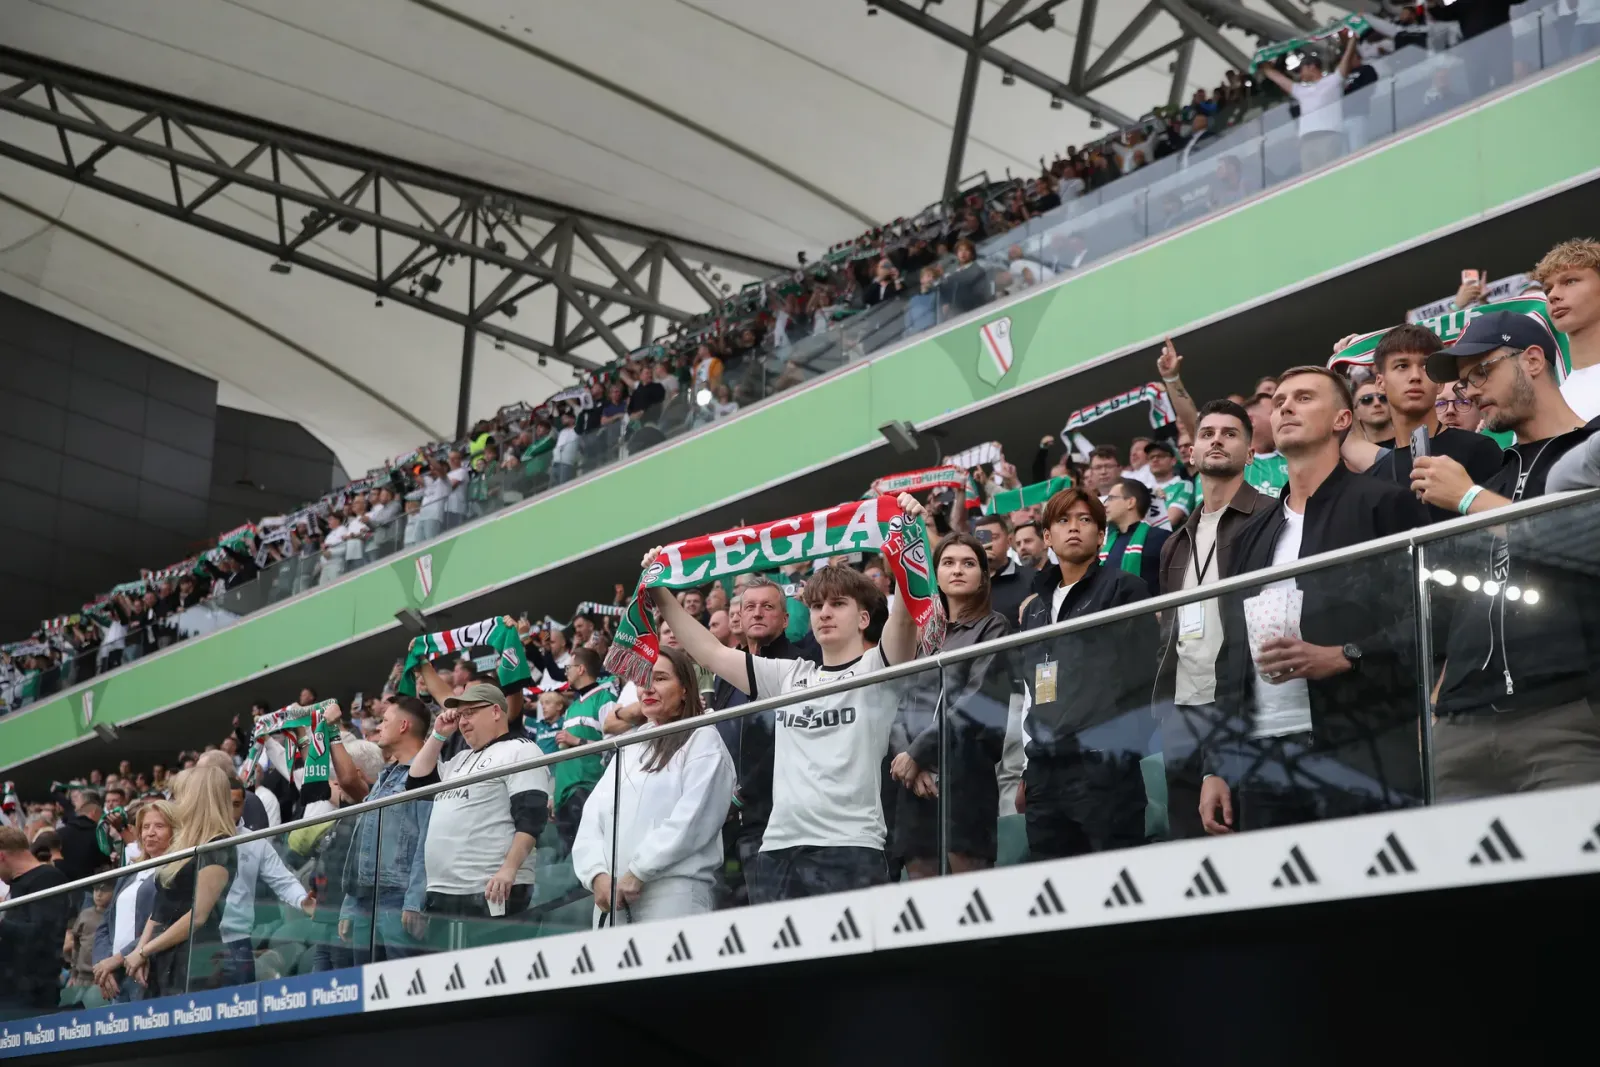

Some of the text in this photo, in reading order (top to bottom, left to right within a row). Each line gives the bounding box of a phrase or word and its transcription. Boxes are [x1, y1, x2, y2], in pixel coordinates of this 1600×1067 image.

[660, 498, 883, 585] LEGIA
[304, 764, 327, 777] 1916
[24, 1029, 55, 1045] Plus500
[59, 1023, 91, 1040] Plus500
[95, 1018, 129, 1036] Plus500
[133, 1012, 170, 1031] Plus500
[174, 1006, 212, 1025] Plus500
[217, 999, 258, 1020] Plus500
[263, 991, 307, 1012] Plus500
[312, 984, 359, 1006] Plus500
